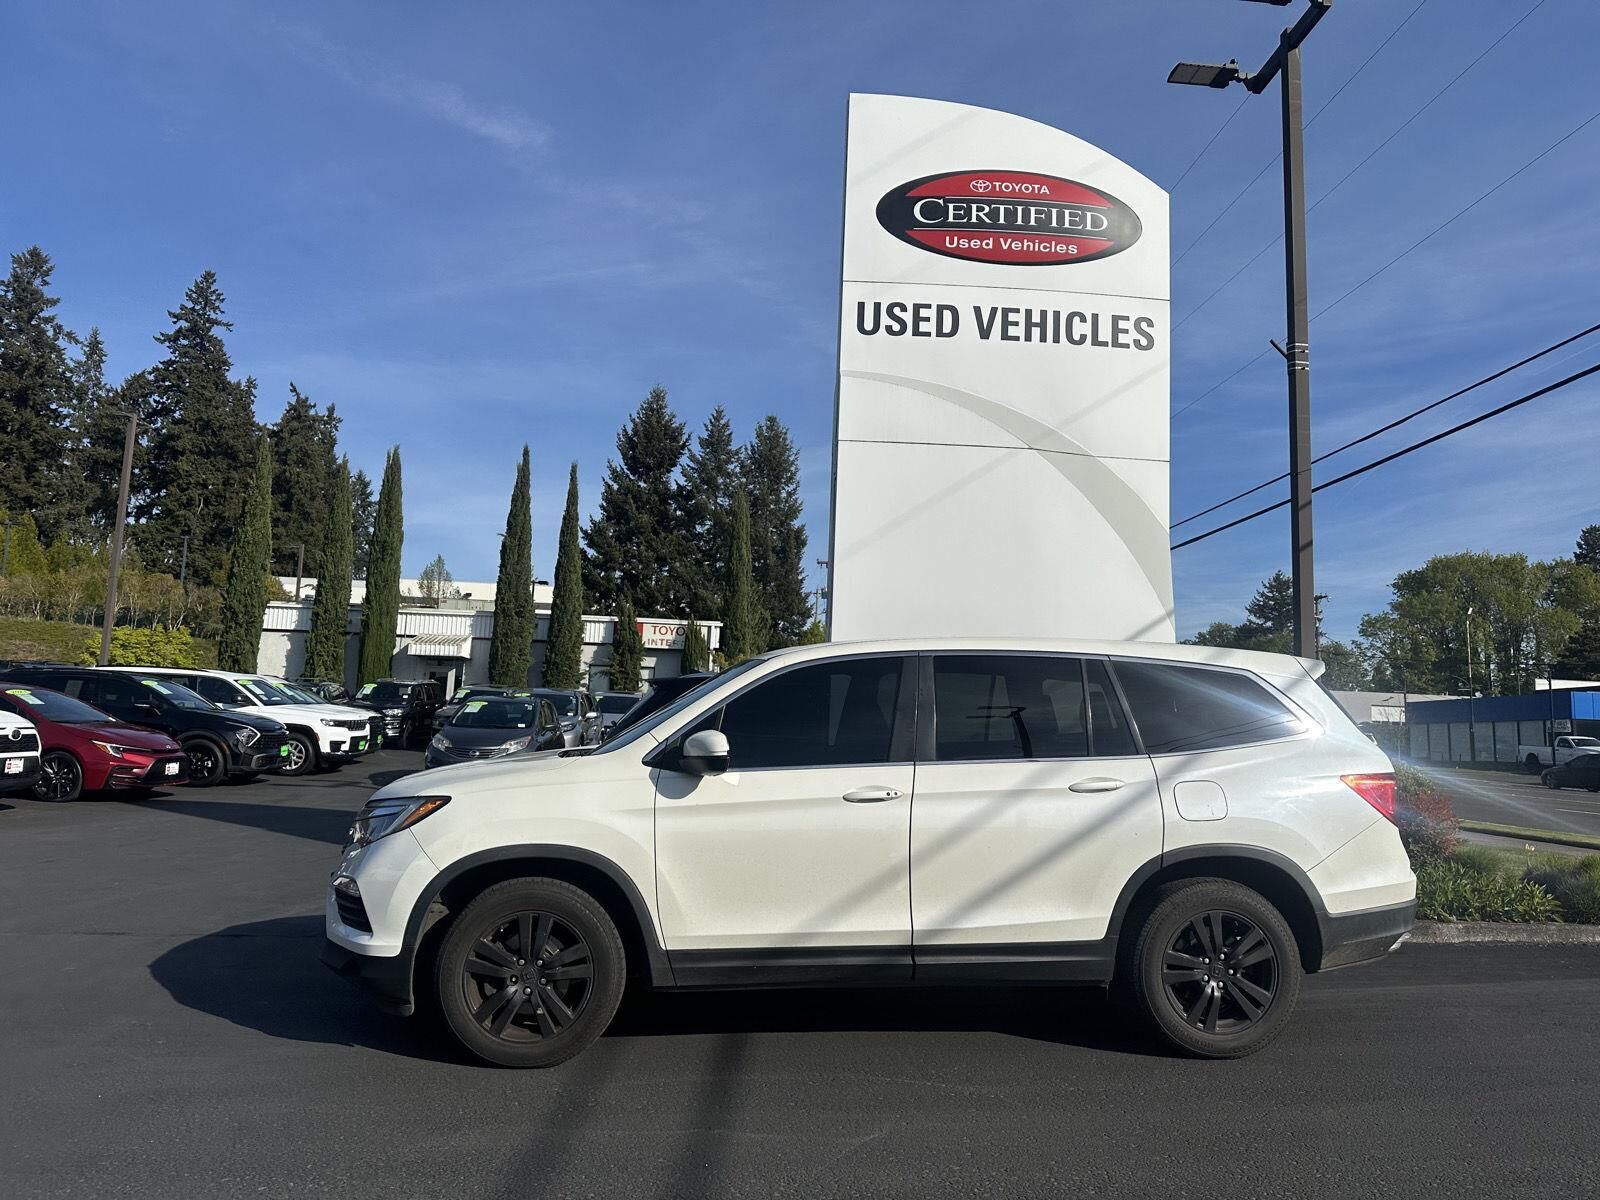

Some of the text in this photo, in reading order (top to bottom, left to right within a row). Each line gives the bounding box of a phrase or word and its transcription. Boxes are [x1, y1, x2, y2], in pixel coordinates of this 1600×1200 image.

[993, 181, 1050, 195] TOYOTA
[913, 198, 1108, 232] CERTIFIED
[945, 235, 1078, 254] Used Vehicles
[856, 301, 1155, 351] USED VEHICLES
[651, 625, 686, 637] TOYO
